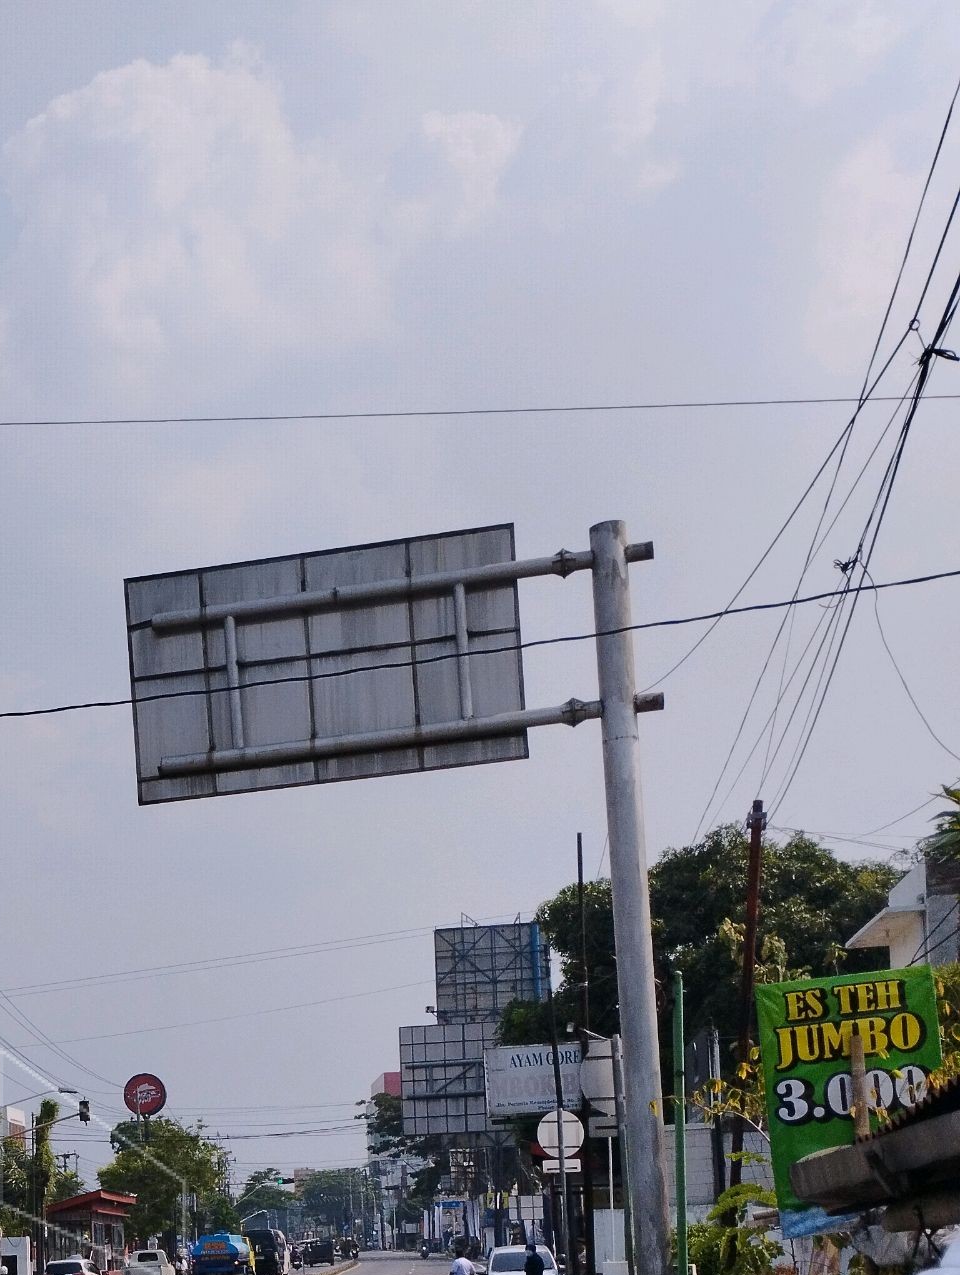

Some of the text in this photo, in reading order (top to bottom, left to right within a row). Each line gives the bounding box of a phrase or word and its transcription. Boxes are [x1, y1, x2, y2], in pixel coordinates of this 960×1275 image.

[784, 980, 903, 1021] ES TEH
[509, 1052, 543, 1069] AYAM
[775, 1012, 921, 1070] JUMBO
[775, 1065, 928, 1121] 3.000
